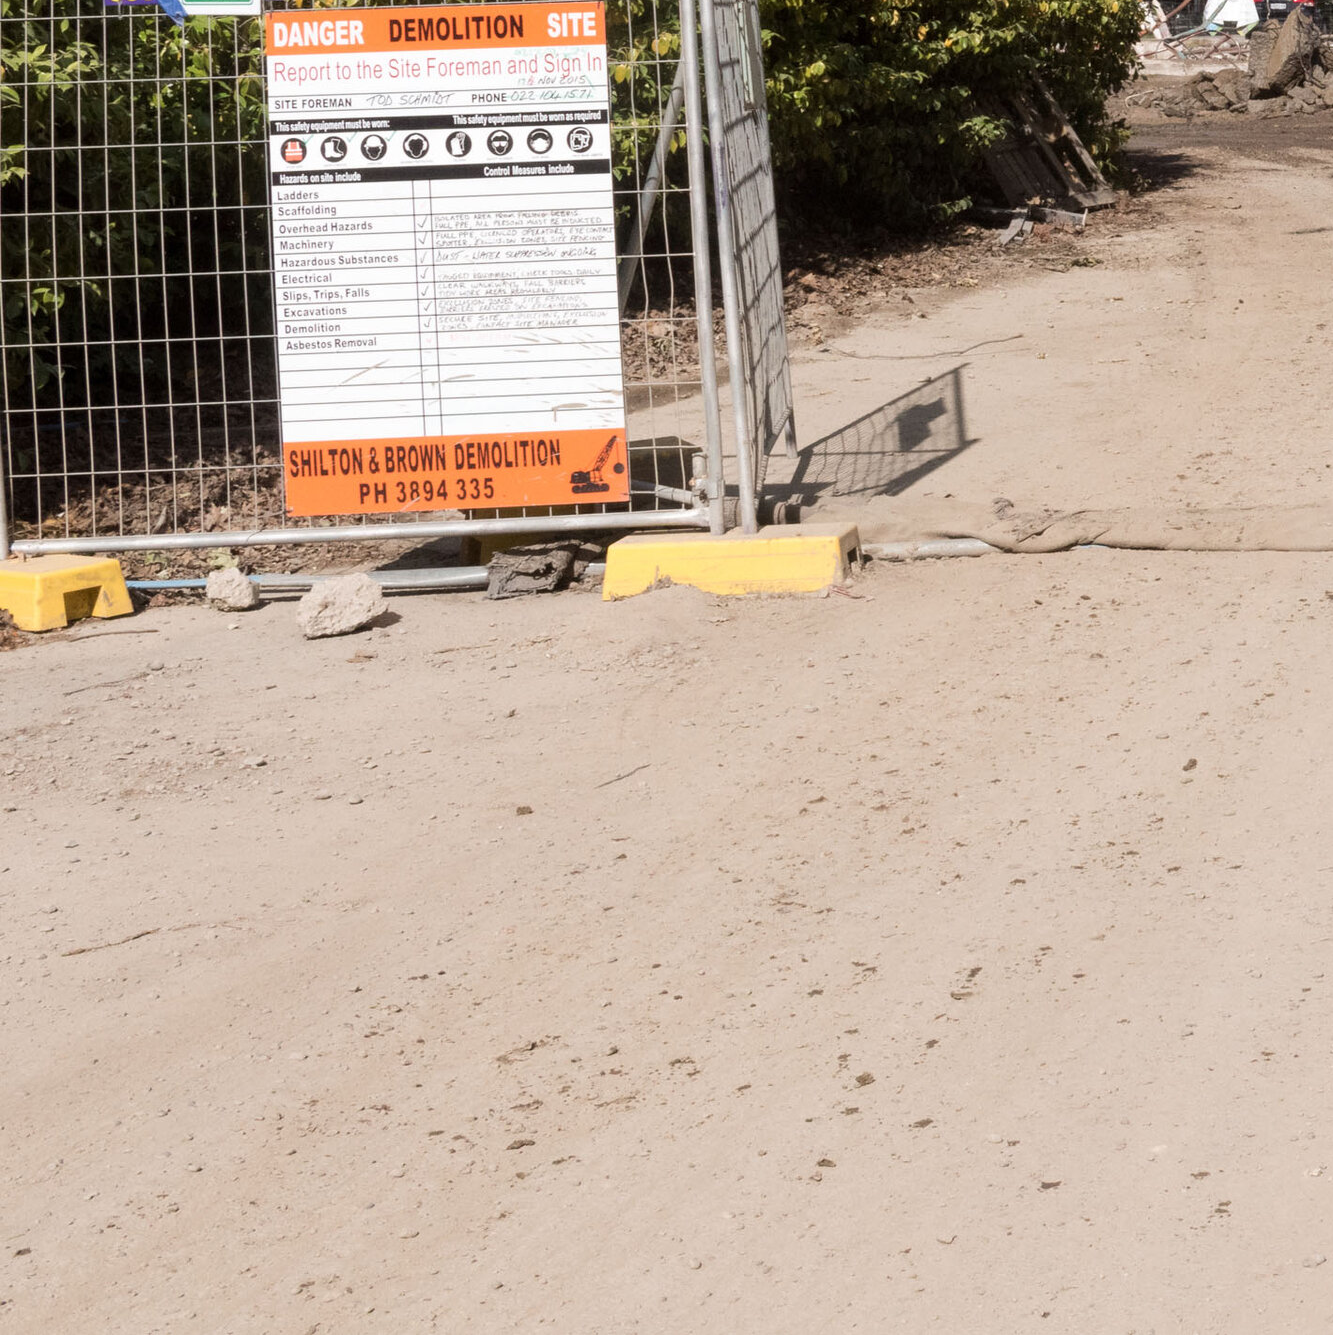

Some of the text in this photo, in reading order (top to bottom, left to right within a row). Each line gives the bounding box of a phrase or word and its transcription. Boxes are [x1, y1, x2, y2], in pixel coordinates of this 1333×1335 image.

[273, 11, 597, 47] DANGER DEMOLITION SITE
[274, 61, 331, 86] Report
[336, 61, 351, 80] to
[357, 59, 383, 79] the
[388, 57, 421, 78] Site
[427, 57, 502, 78] Foreman
[507, 54, 538, 75] and
[544, 52, 581, 78] Sign
[587, 51, 602, 71] In
[559, 74, 586, 85] 2015
[275, 93, 507, 109] SITE FOREMAN PHONE
[510, 90, 535, 101] 022
[453, 110, 602, 126] This safety equipment must be worn as required
[275, 122, 290, 132] This
[290, 120, 310, 133] safety
[311, 120, 345, 132] equipment
[346, 119, 362, 129] must
[363, 119, 371, 128] be
[484, 164, 574, 177] Control Measures include
[280, 171, 361, 184] Hazards on site include
[277, 191, 319, 201] Ladders
[278, 205, 337, 217] Scaffolding
[279, 220, 373, 234] Overhead Hazards
[280, 239, 334, 251] Machinery
[281, 254, 399, 268] Hazardous Substances
[282, 273, 332, 284] Electrical
[283, 288, 370, 301] Slips, Trips, Falls
[284, 306, 347, 317] Excavations
[285, 323, 341, 334] Demolition
[286, 337, 377, 351] Asbestos Removal
[290, 438, 561, 477] SHILTON & BROWN DEMOLITION
[359, 477, 495, 504] PH 3894 335
